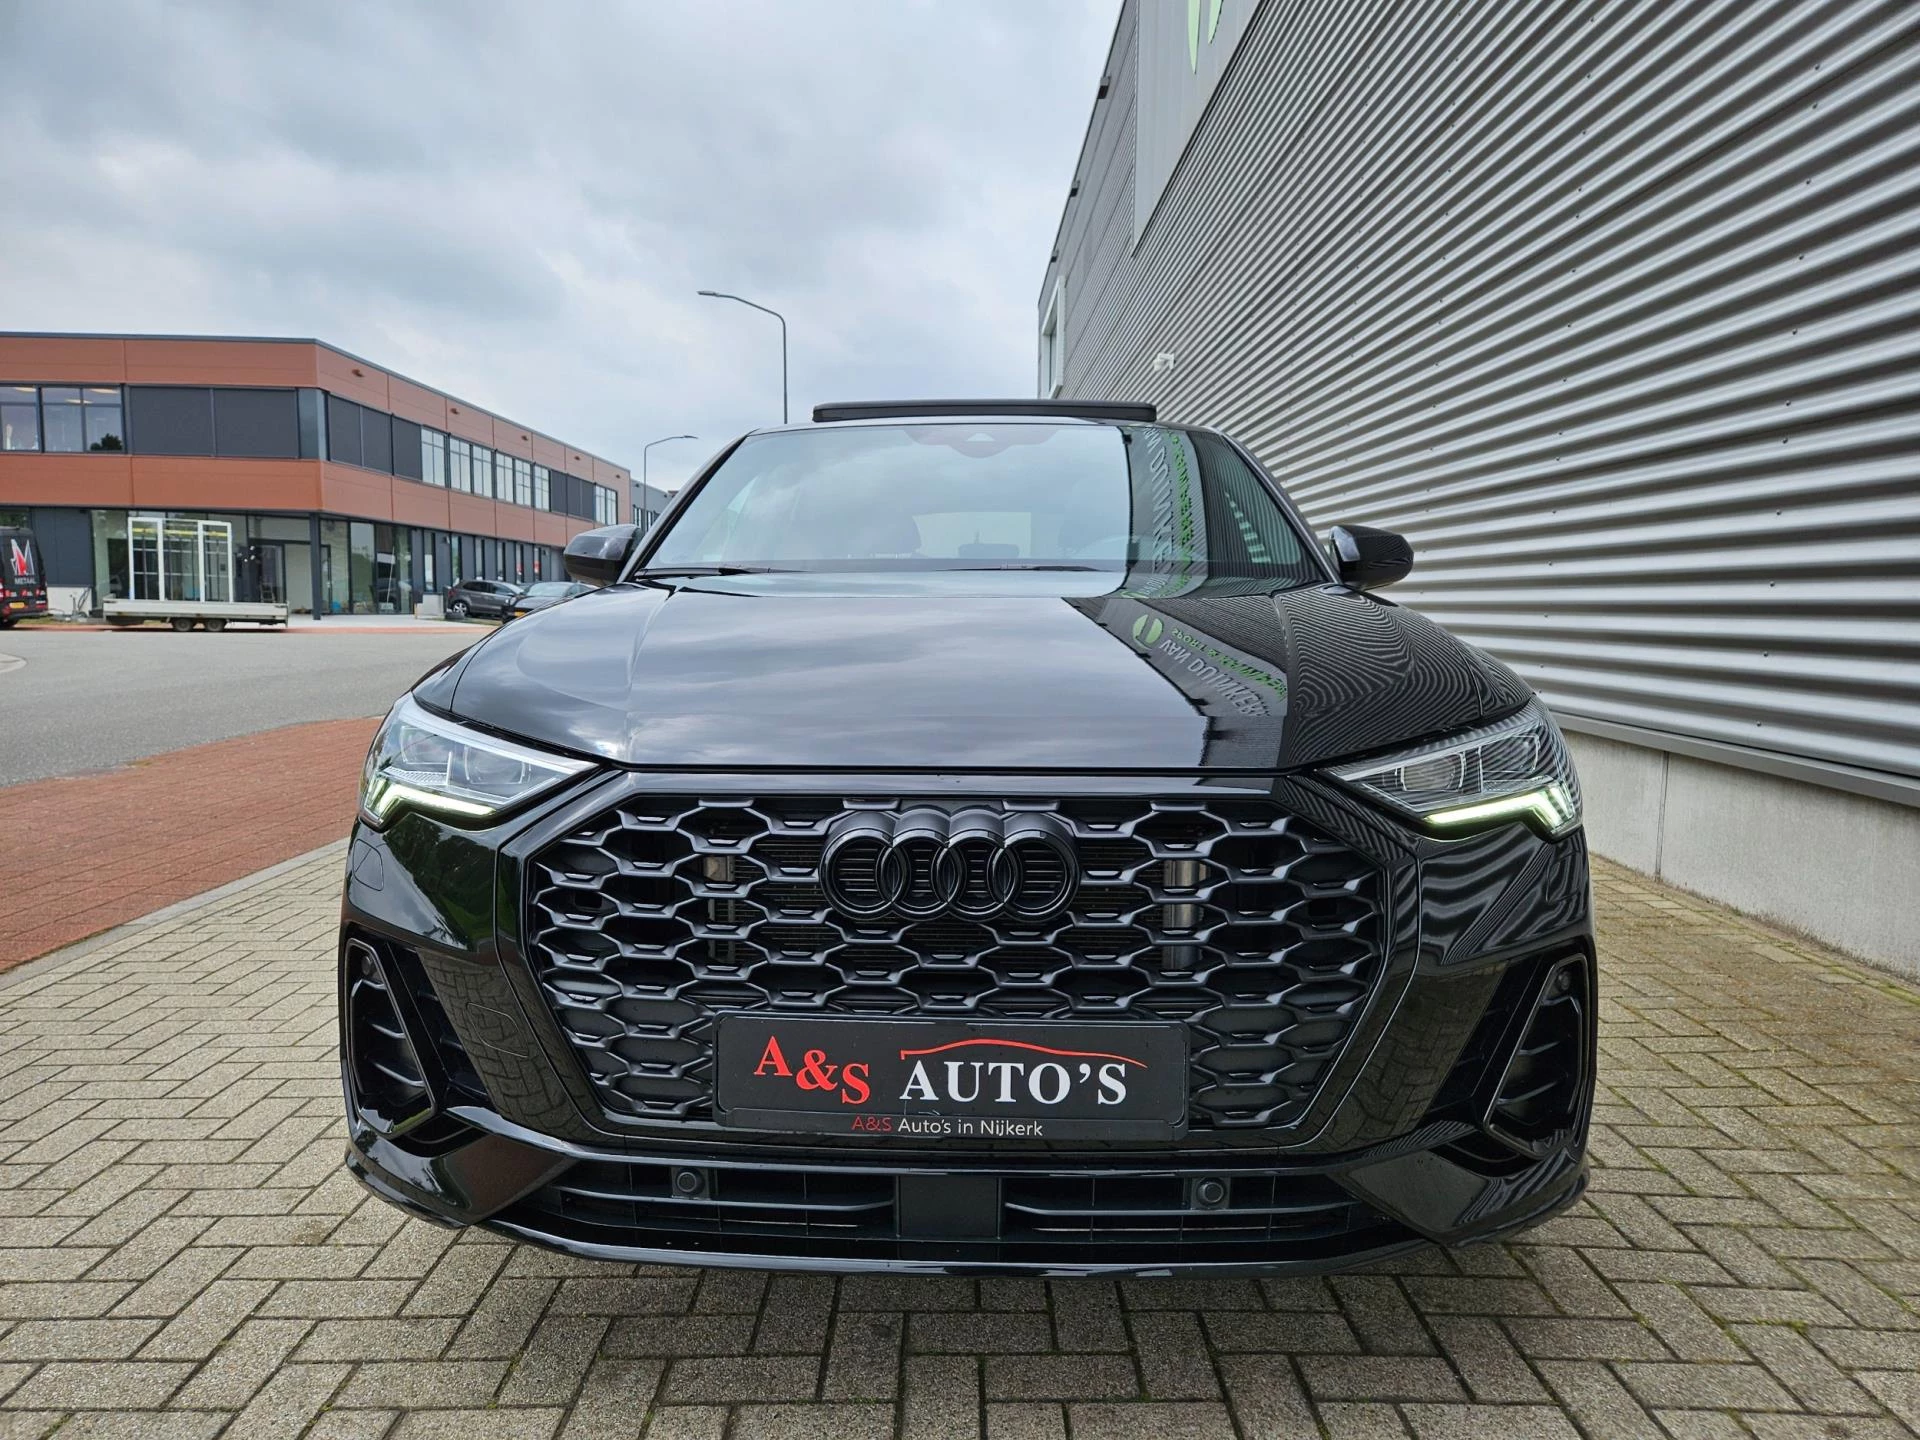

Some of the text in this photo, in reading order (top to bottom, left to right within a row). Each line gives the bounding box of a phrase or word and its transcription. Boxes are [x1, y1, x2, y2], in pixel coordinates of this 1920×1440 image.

[753, 1035, 1127, 1105] A&S AUTO'S
[851, 1116, 1043, 1136] A&S Auto's in Nijkerk
